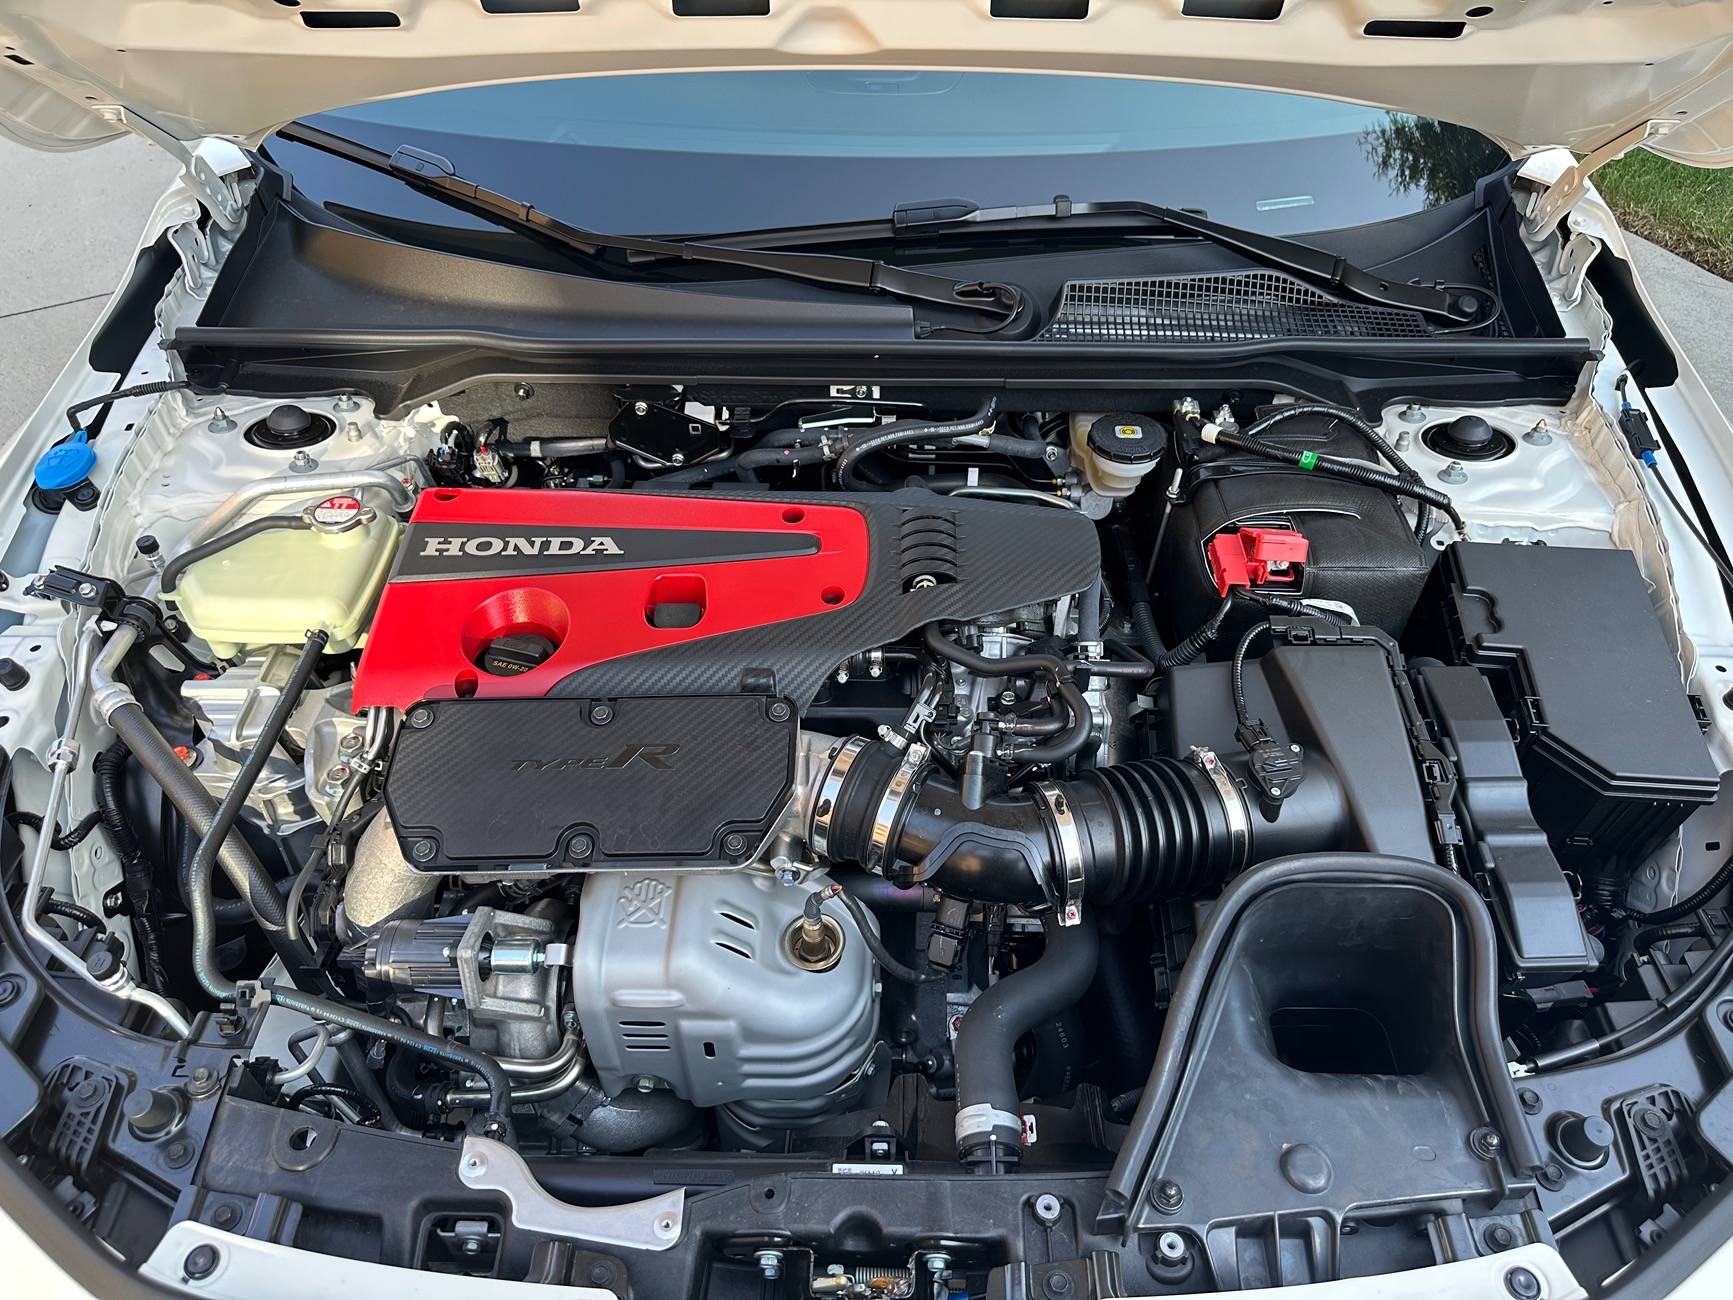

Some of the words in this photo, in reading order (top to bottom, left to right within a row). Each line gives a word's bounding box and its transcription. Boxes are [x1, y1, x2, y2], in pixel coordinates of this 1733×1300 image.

[420, 536, 624, 556] HONDA
[492, 660, 507, 669] SAE
[507, 663, 529, 673] 0W-20
[511, 757, 608, 772] TYPE
[606, 743, 682, 771] R
